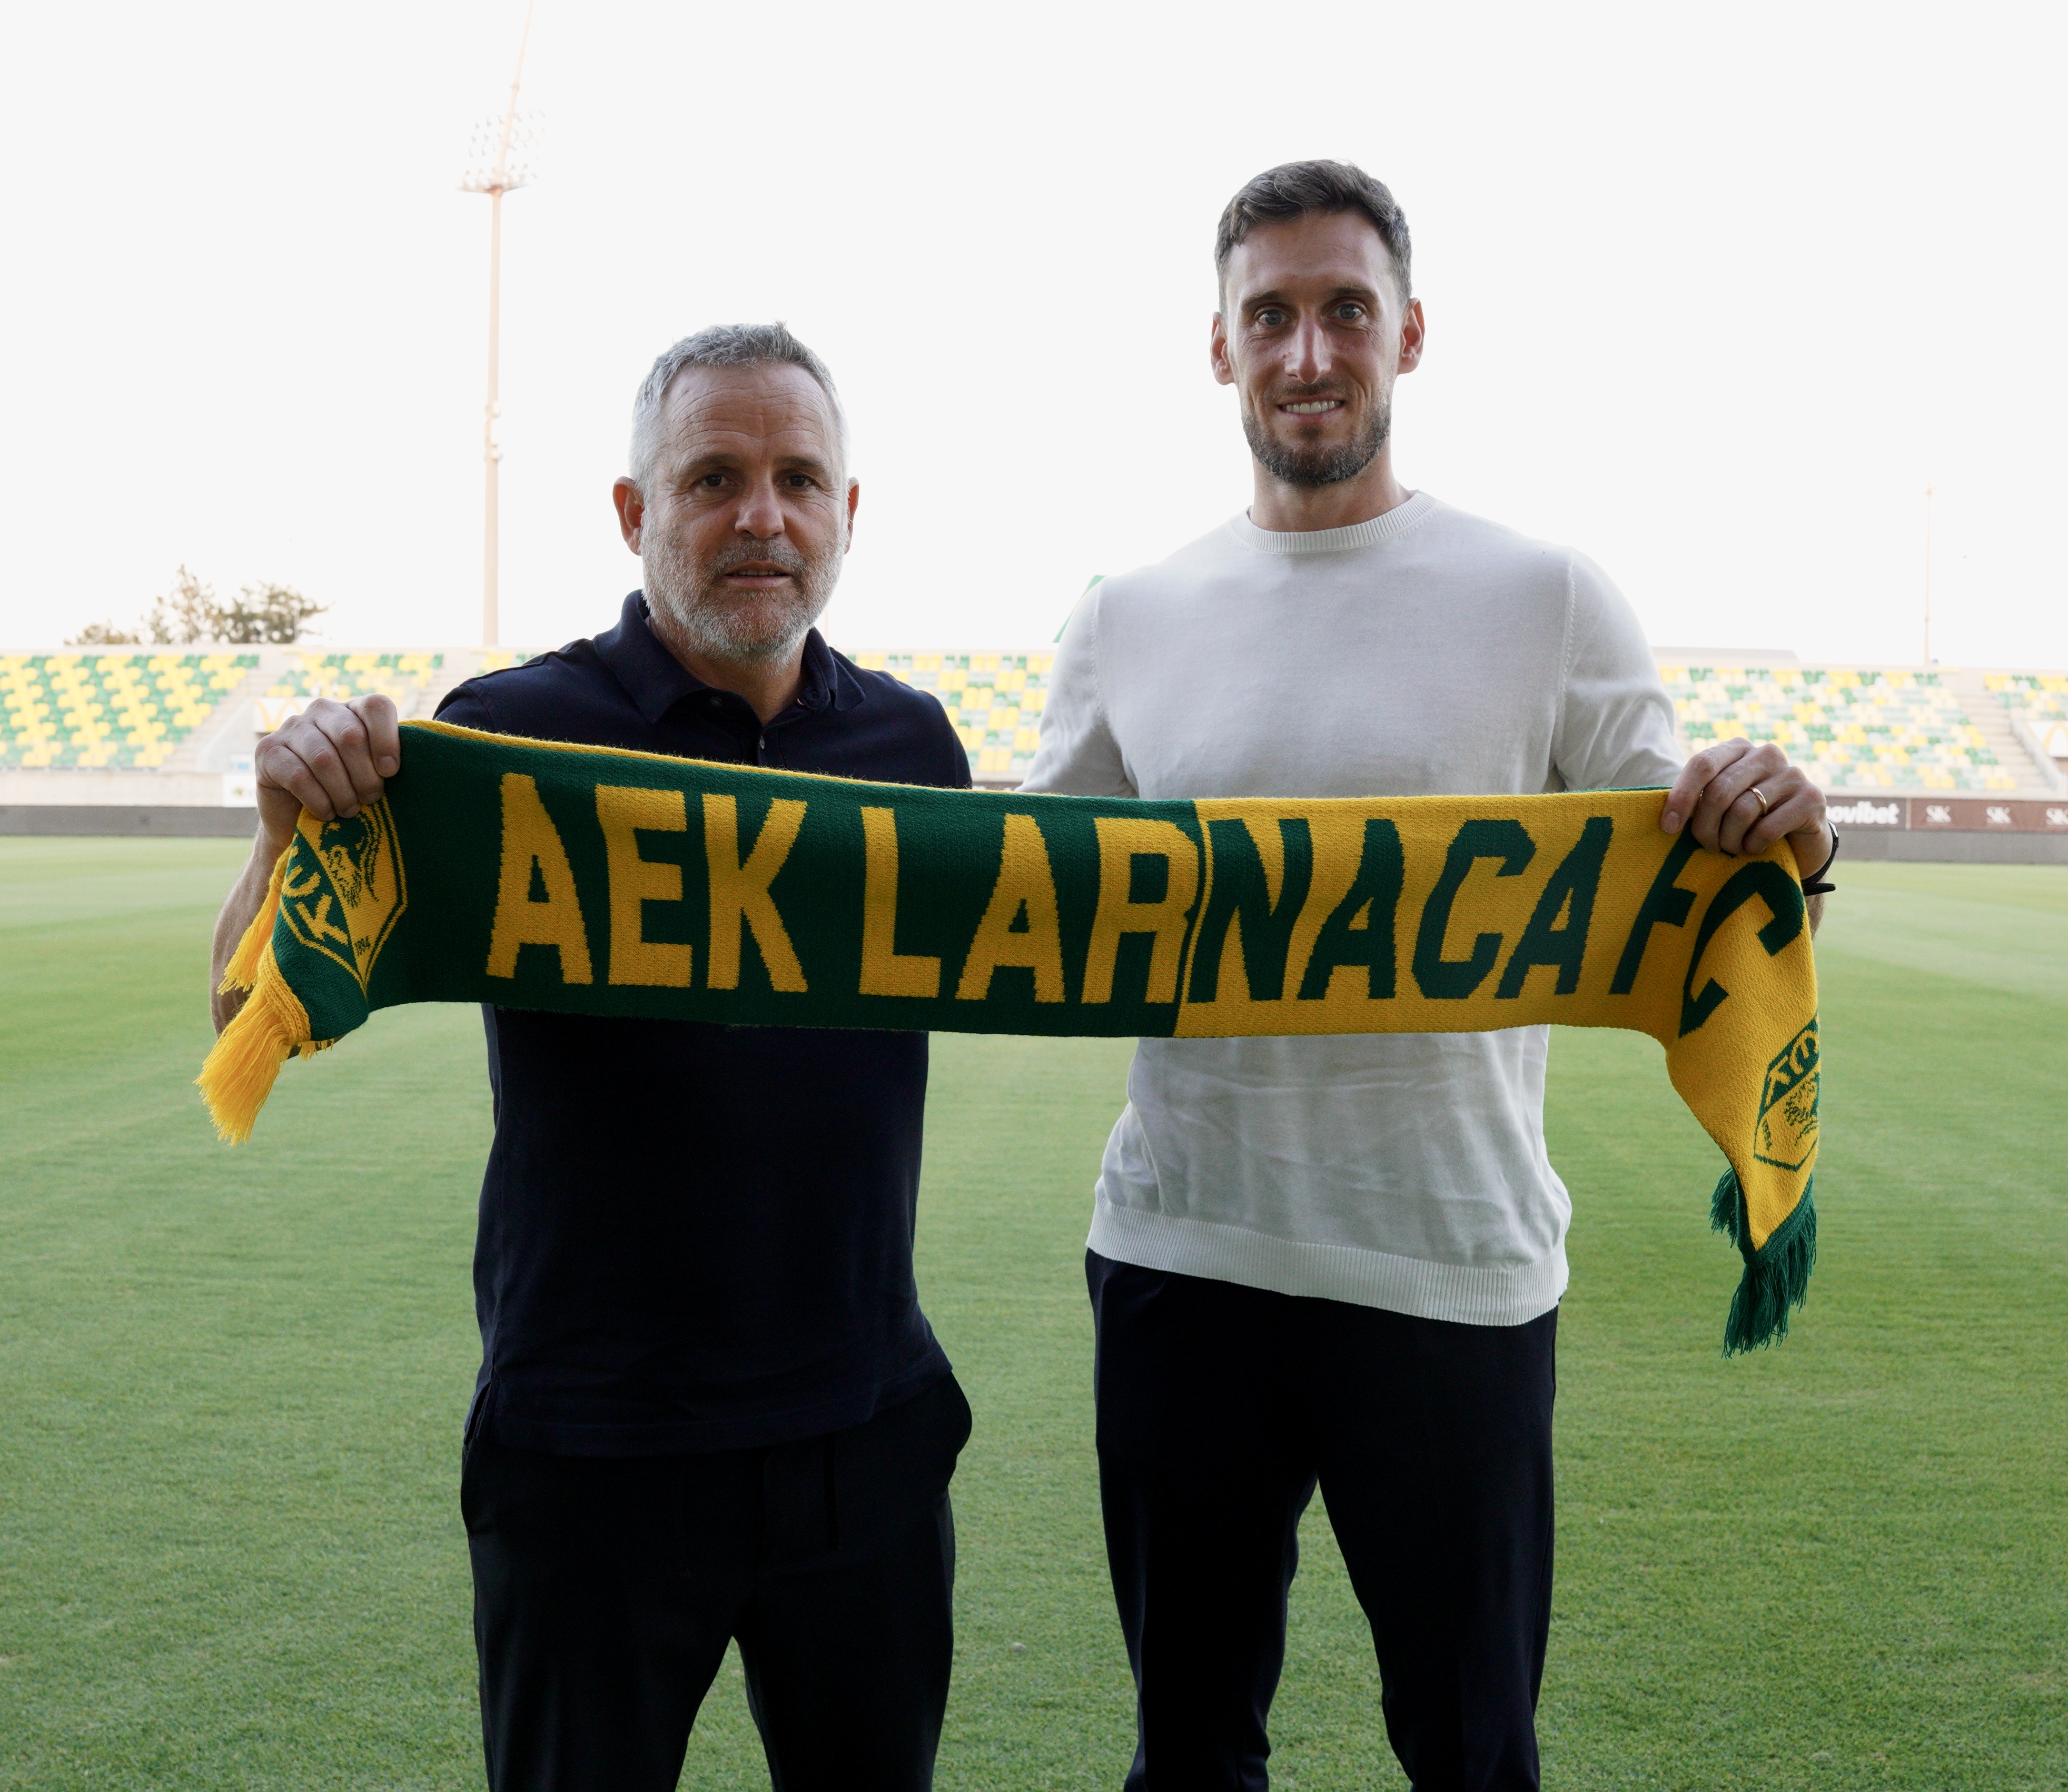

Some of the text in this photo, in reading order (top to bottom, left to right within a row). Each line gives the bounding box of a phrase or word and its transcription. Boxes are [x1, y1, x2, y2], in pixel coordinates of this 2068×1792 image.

[486, 772, 1805, 1038] AEK LARNACA FC
